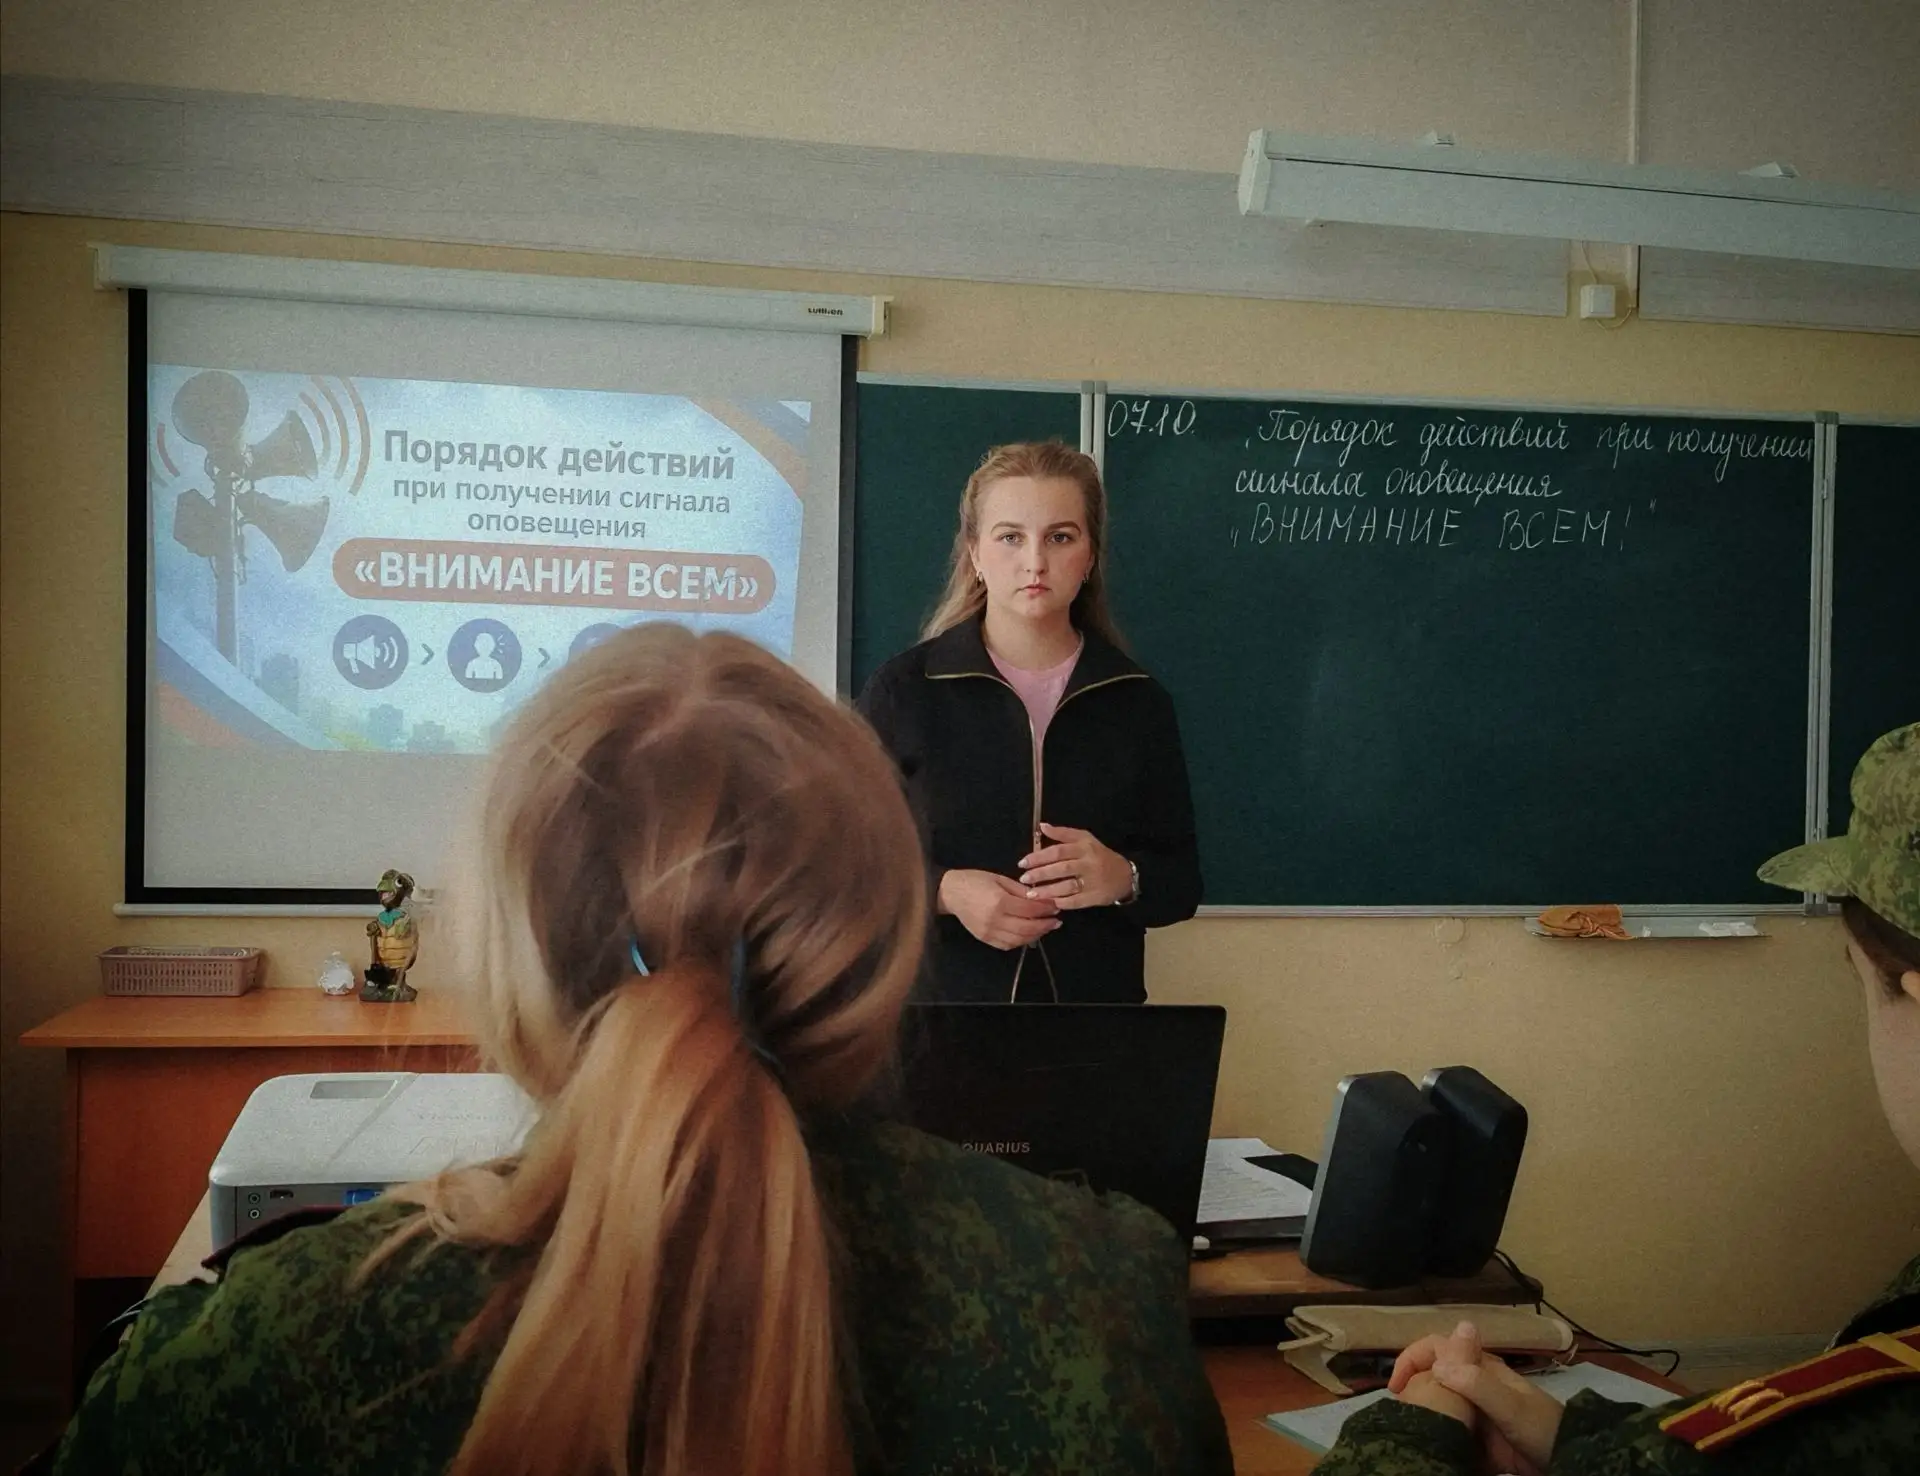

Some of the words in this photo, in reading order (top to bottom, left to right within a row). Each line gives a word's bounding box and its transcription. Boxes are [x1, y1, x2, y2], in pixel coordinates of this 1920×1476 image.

[384, 429, 548, 472] Порядок
[557, 440, 735, 480] действий
[1419, 415, 1570, 466] действий
[1596, 422, 1655, 469] при
[1667, 428, 1814, 484] получении
[393, 479, 446, 504] при
[456, 482, 611, 509] получении
[618, 490, 731, 514] сигнала
[1235, 468, 1368, 498] сигнала
[1385, 458, 1563, 507] оповещения
[467, 512, 647, 539] оповещения
[354, 550, 615, 596] «ВНИМАНИЕ
[626, 561, 760, 602] ВСЕМ»
[961, 1141, 1031, 1154] QUARIUS
